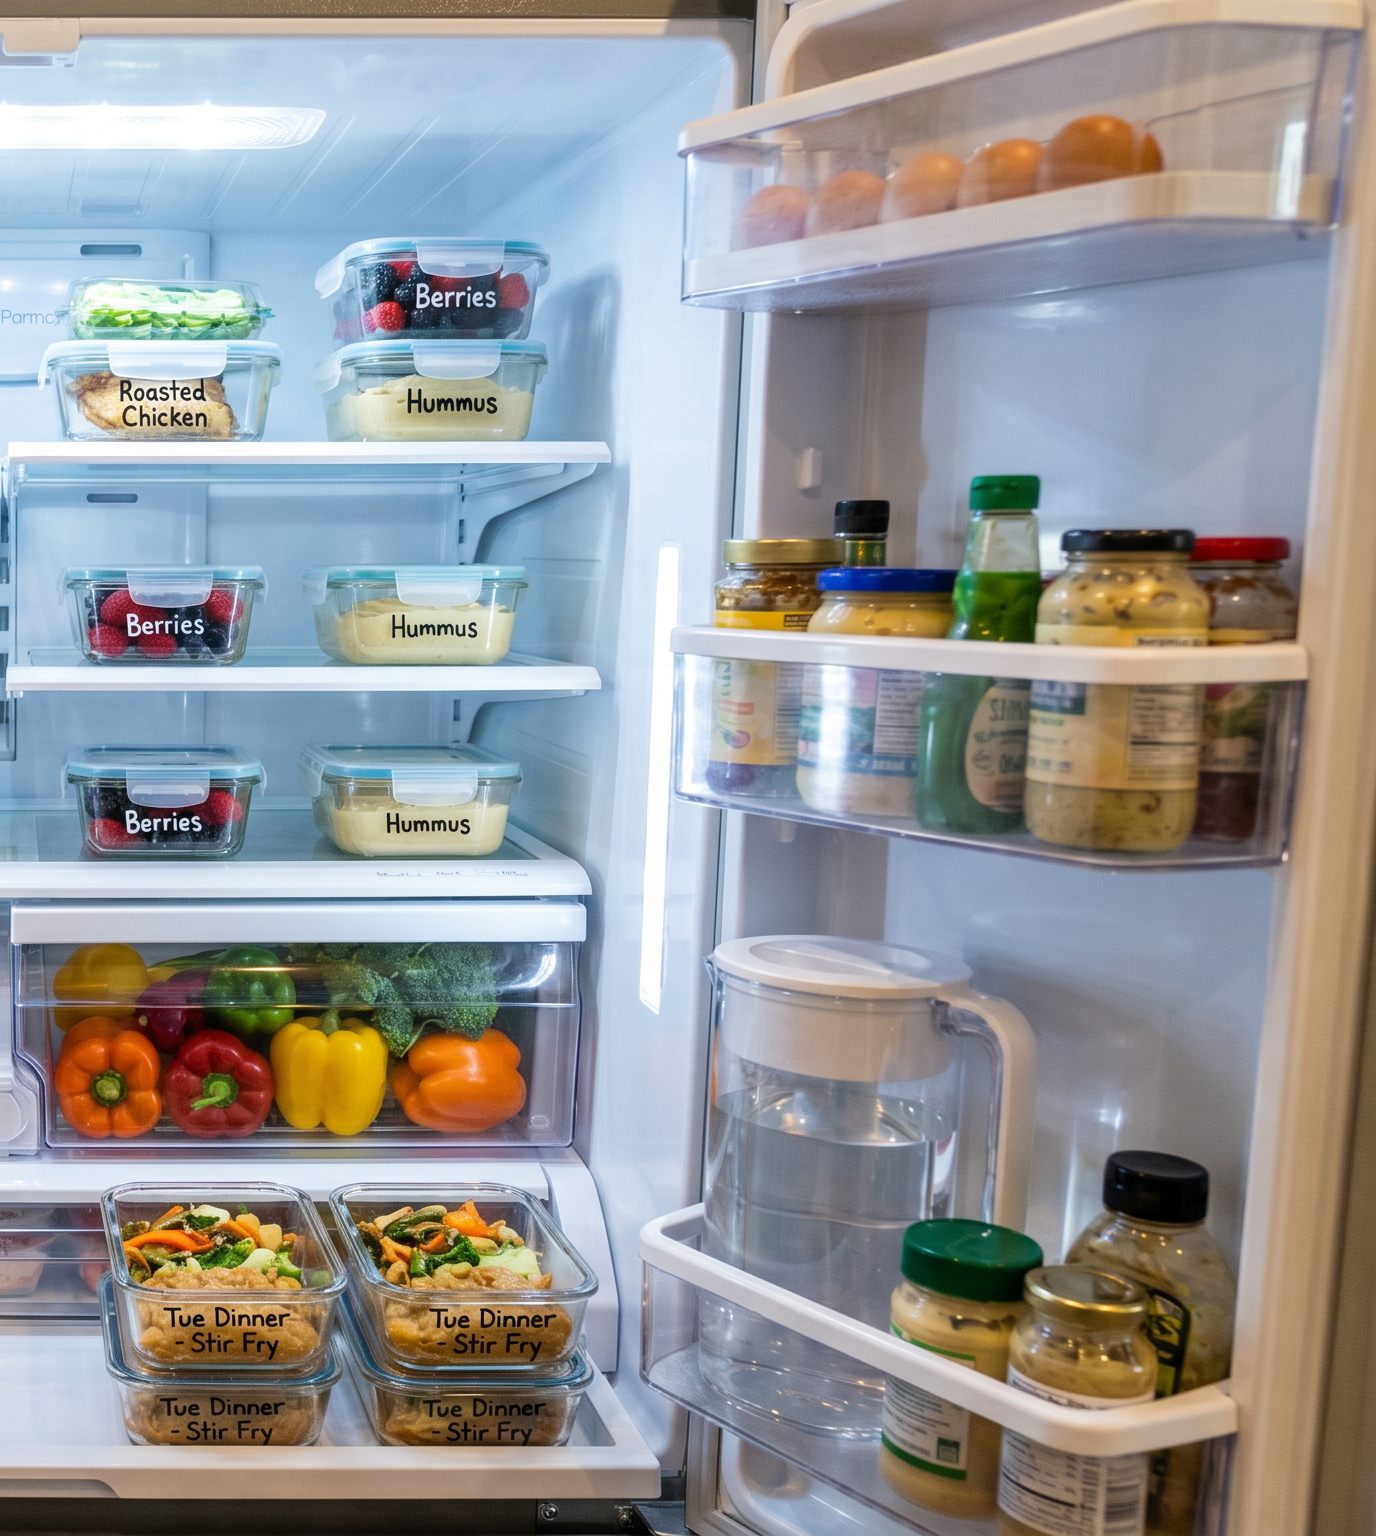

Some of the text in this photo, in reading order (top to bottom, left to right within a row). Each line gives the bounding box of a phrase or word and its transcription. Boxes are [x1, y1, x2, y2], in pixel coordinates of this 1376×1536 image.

[415, 283, 497, 309] Berries
[119, 378, 208, 403] Roasted
[407, 387, 498, 415] Hummus
[121, 405, 208, 429] Chicken
[126, 613, 205, 637] Berries
[391, 613, 478, 640] Hummus
[125, 809, 203, 834] Berries
[385, 812, 472, 836] Hummus
[163, 1306, 291, 1328] Tue Dinner
[428, 1308, 557, 1330] Tue Dinner
[191, 1332, 235, 1354] Stir
[241, 1331, 279, 1361] Fry
[453, 1332, 498, 1355] Stir
[506, 1332, 543, 1362] Fry
[159, 1396, 287, 1418] Tue Dinner
[422, 1397, 547, 1419] Tue Dinner
[185, 1421, 230, 1442] Stir
[237, 1420, 274, 1446] Fry
[448, 1421, 490, 1443] Stir
[498, 1421, 535, 1447] Fry
